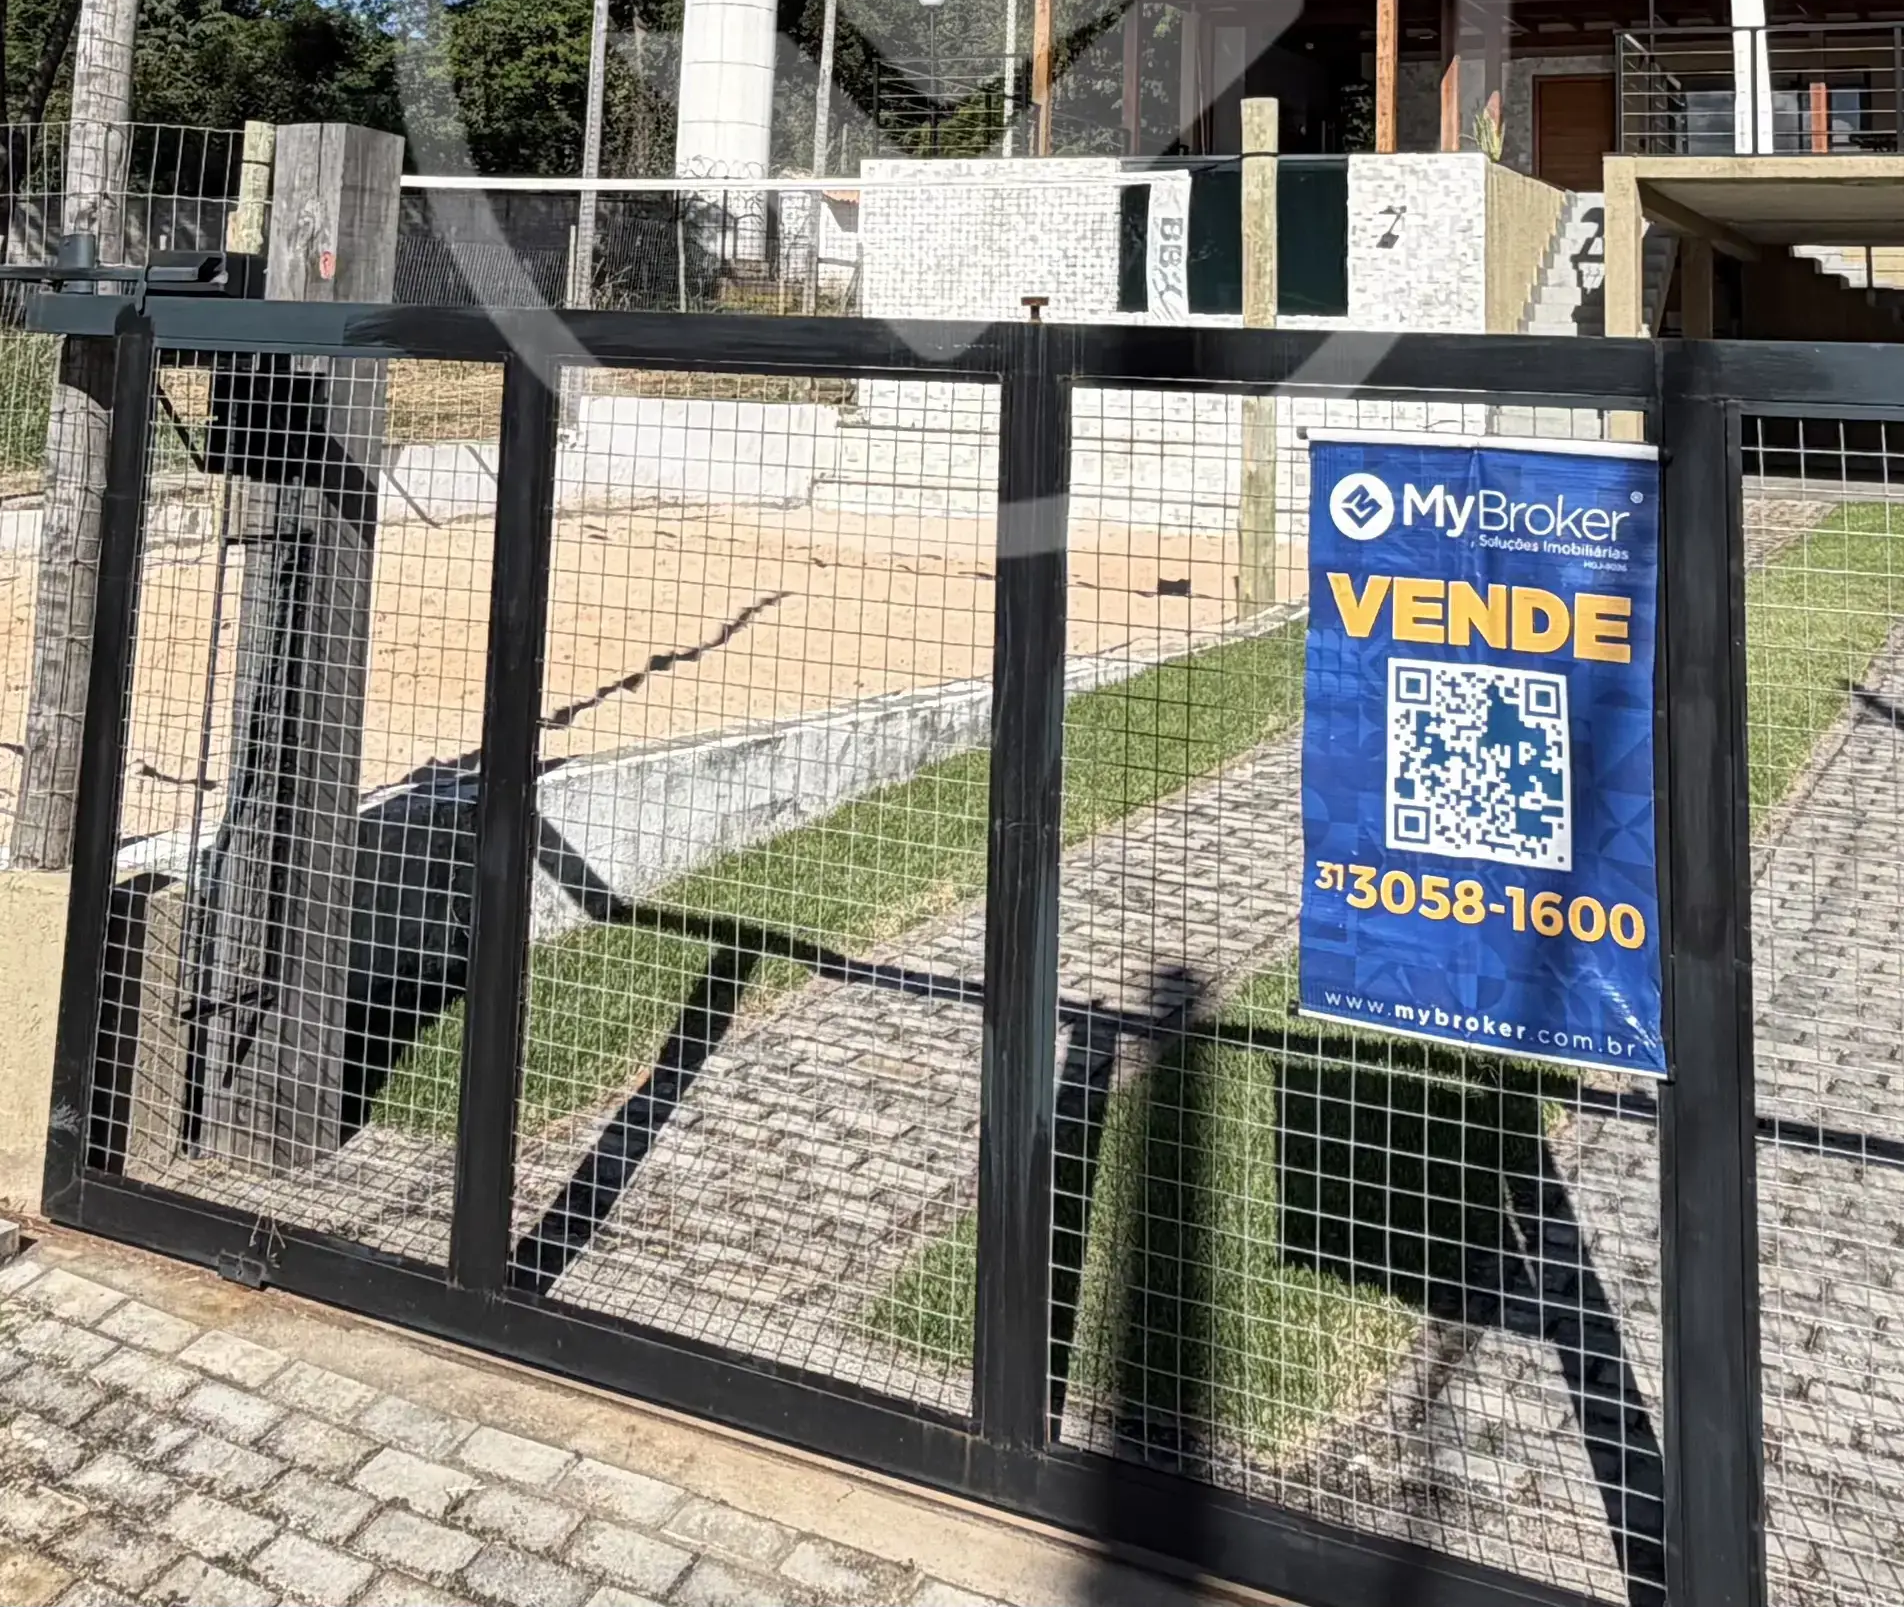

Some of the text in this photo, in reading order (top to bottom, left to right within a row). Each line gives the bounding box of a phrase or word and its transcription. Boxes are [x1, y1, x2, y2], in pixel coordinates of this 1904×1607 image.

[1402, 482, 1630, 542] MyBroker
[1478, 533, 1630, 561] Soluções Imobiliárias
[1326, 571, 1632, 664] VENDE
[1346, 864, 1646, 950] 3058-1600
[1324, 990, 1636, 1059] www.mybroker.com.br
